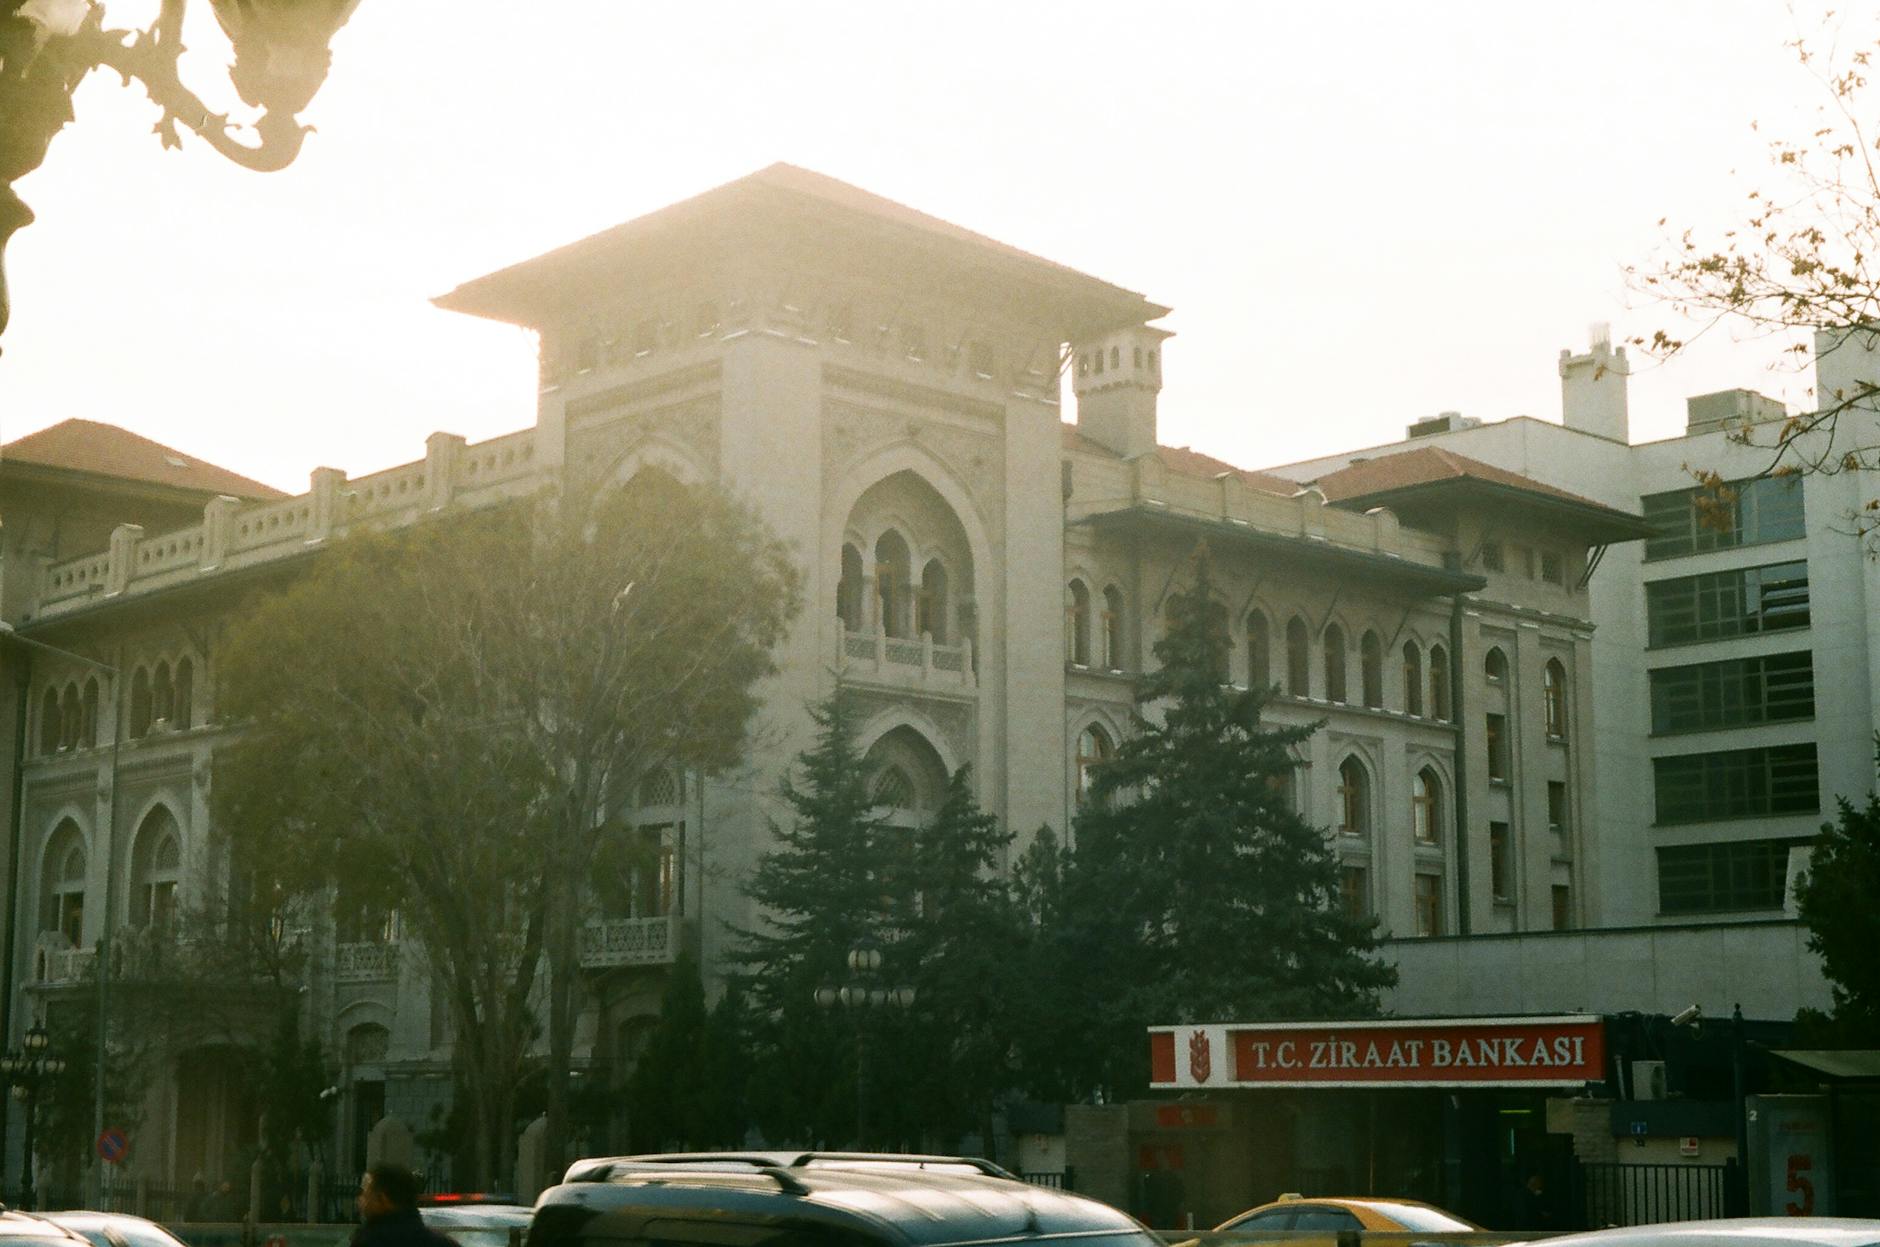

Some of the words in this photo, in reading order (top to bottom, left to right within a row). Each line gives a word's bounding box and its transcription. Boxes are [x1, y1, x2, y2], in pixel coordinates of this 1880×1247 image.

[1252, 1041, 1303, 1069] T.C.
[1309, 1035, 1424, 1068] ZİRAAT
[1431, 1036, 1585, 1067] BANKASI
[1786, 1154, 1815, 1216] 5
